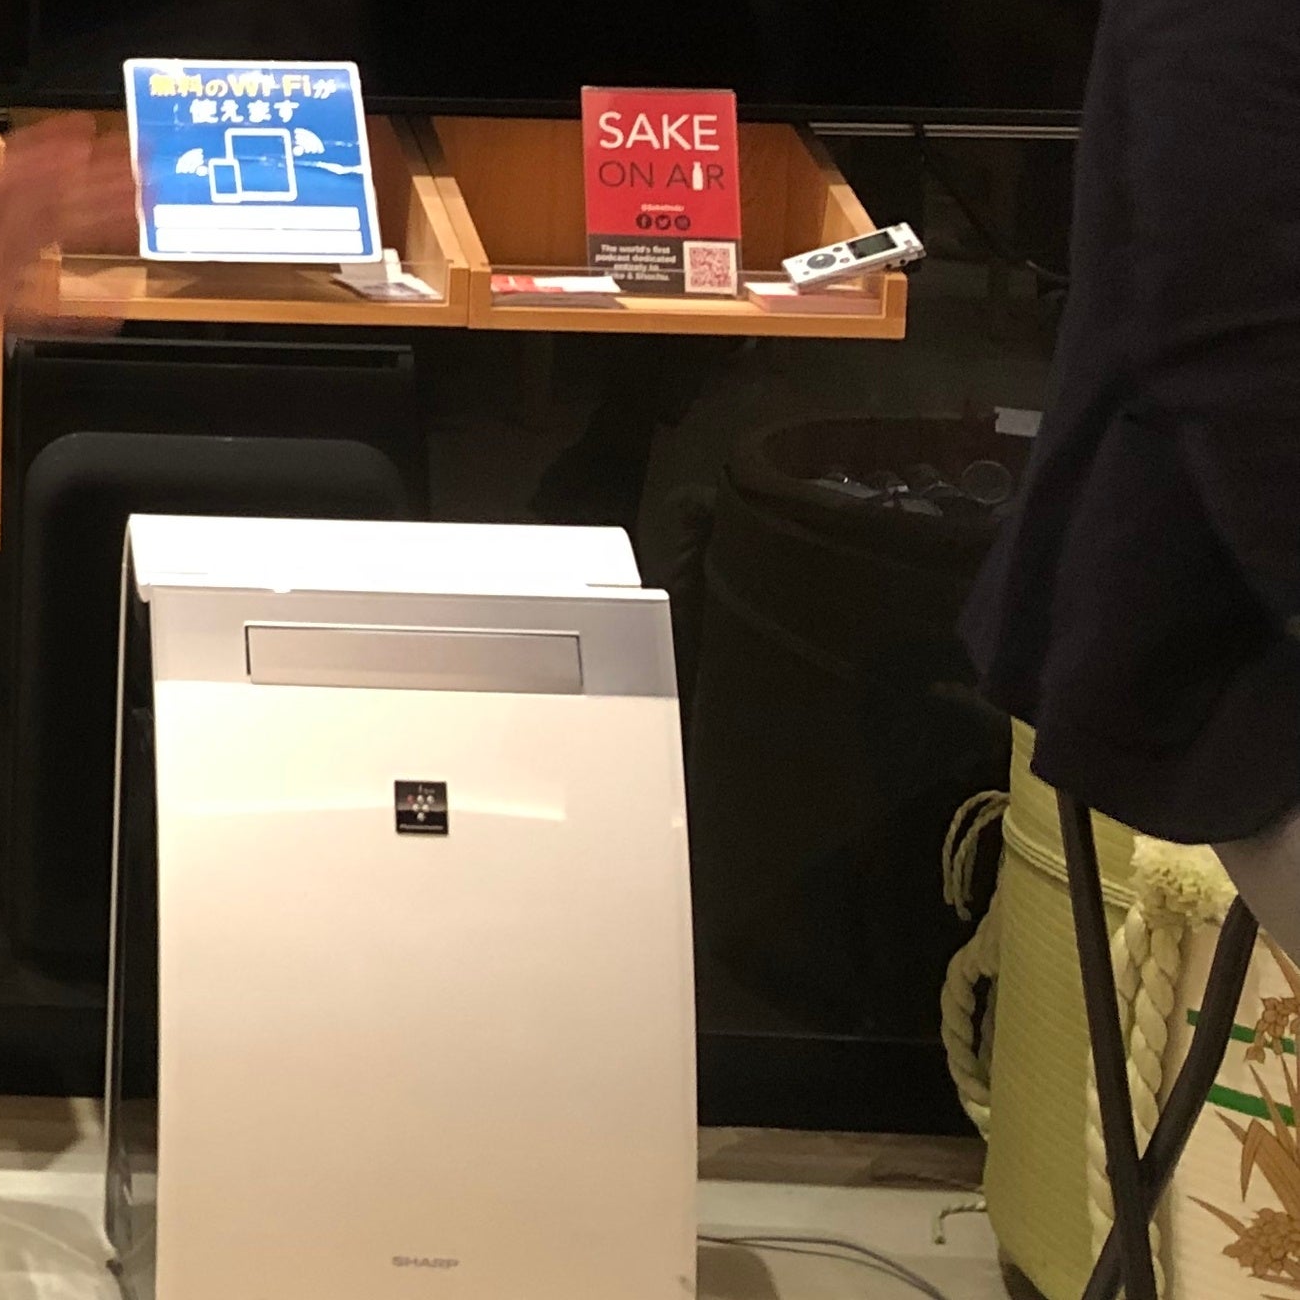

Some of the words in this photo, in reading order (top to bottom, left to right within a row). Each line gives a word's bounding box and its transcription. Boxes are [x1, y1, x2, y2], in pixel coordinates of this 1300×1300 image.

[189, 99, 300, 123] 使えます
[598, 111, 720, 151] SAKE
[598, 161, 655, 188] ON
[666, 161, 725, 191] AIR
